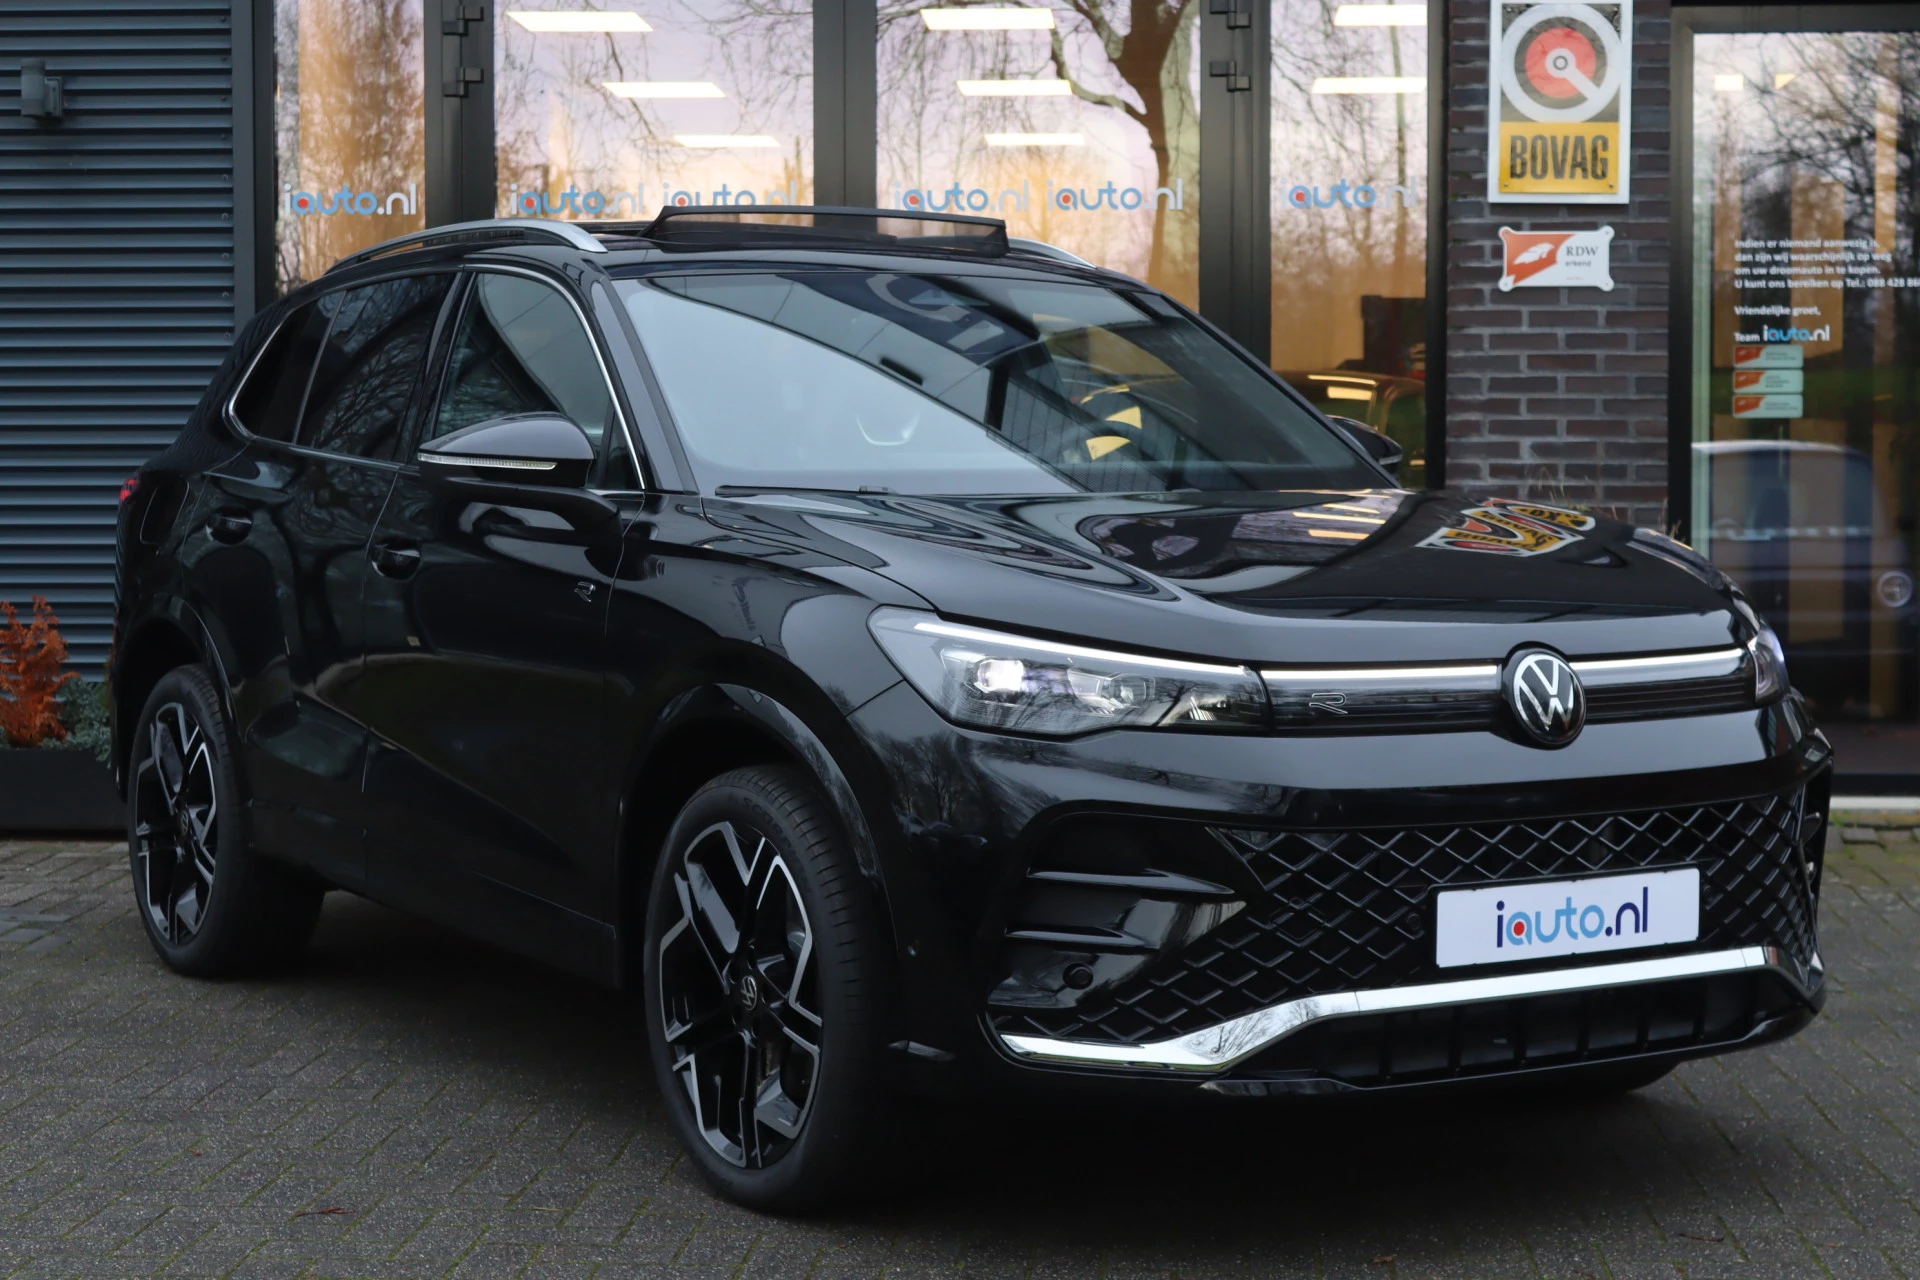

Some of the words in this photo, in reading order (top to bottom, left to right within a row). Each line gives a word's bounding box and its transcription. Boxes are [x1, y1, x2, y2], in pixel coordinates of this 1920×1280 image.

[1509, 134, 1610, 181] BOVAG
[284, 183, 417, 215] iauto.nl
[510, 182, 645, 215] iauto.nl
[662, 180, 797, 207] iautonl
[894, 180, 1030, 213] iauto.nl
[1047, 178, 1184, 211] iauto.nl
[1281, 176, 1417, 209] iauto.nl
[1565, 246, 1600, 257] RDW
[1734, 238, 1765, 249] Indien
[1766, 240, 1778, 249] er
[1779, 238, 1821, 248] niemand
[1823, 239, 1868, 250] aanwezig
[1734, 252, 1754, 262] dan
[1754, 252, 1772, 263] zijn
[1773, 252, 1789, 264] wij
[1790, 251, 1856, 263] waarschijnlijk
[1856, 253, 1870, 263] op
[1871, 253, 1892, 263] weg
[1734, 266, 1751, 276] om
[1752, 266, 1768, 275] uw
[1769, 265, 1824, 275] droomauto
[1824, 265, 1835, 274] in
[1836, 266, 1847, 275] te
[1734, 280, 1743, 289] U
[1744, 278, 1767, 289] kunt
[1768, 280, 1786, 289] ons
[1787, 278, 1829, 288] bereiken
[1830, 280, 1844, 290] op
[1733, 305, 1791, 317] Vriendelijke
[1733, 332, 1761, 342] Team
[1763, 324, 1830, 342] iauto.nl
[1496, 886, 1649, 949] iauto.nl
